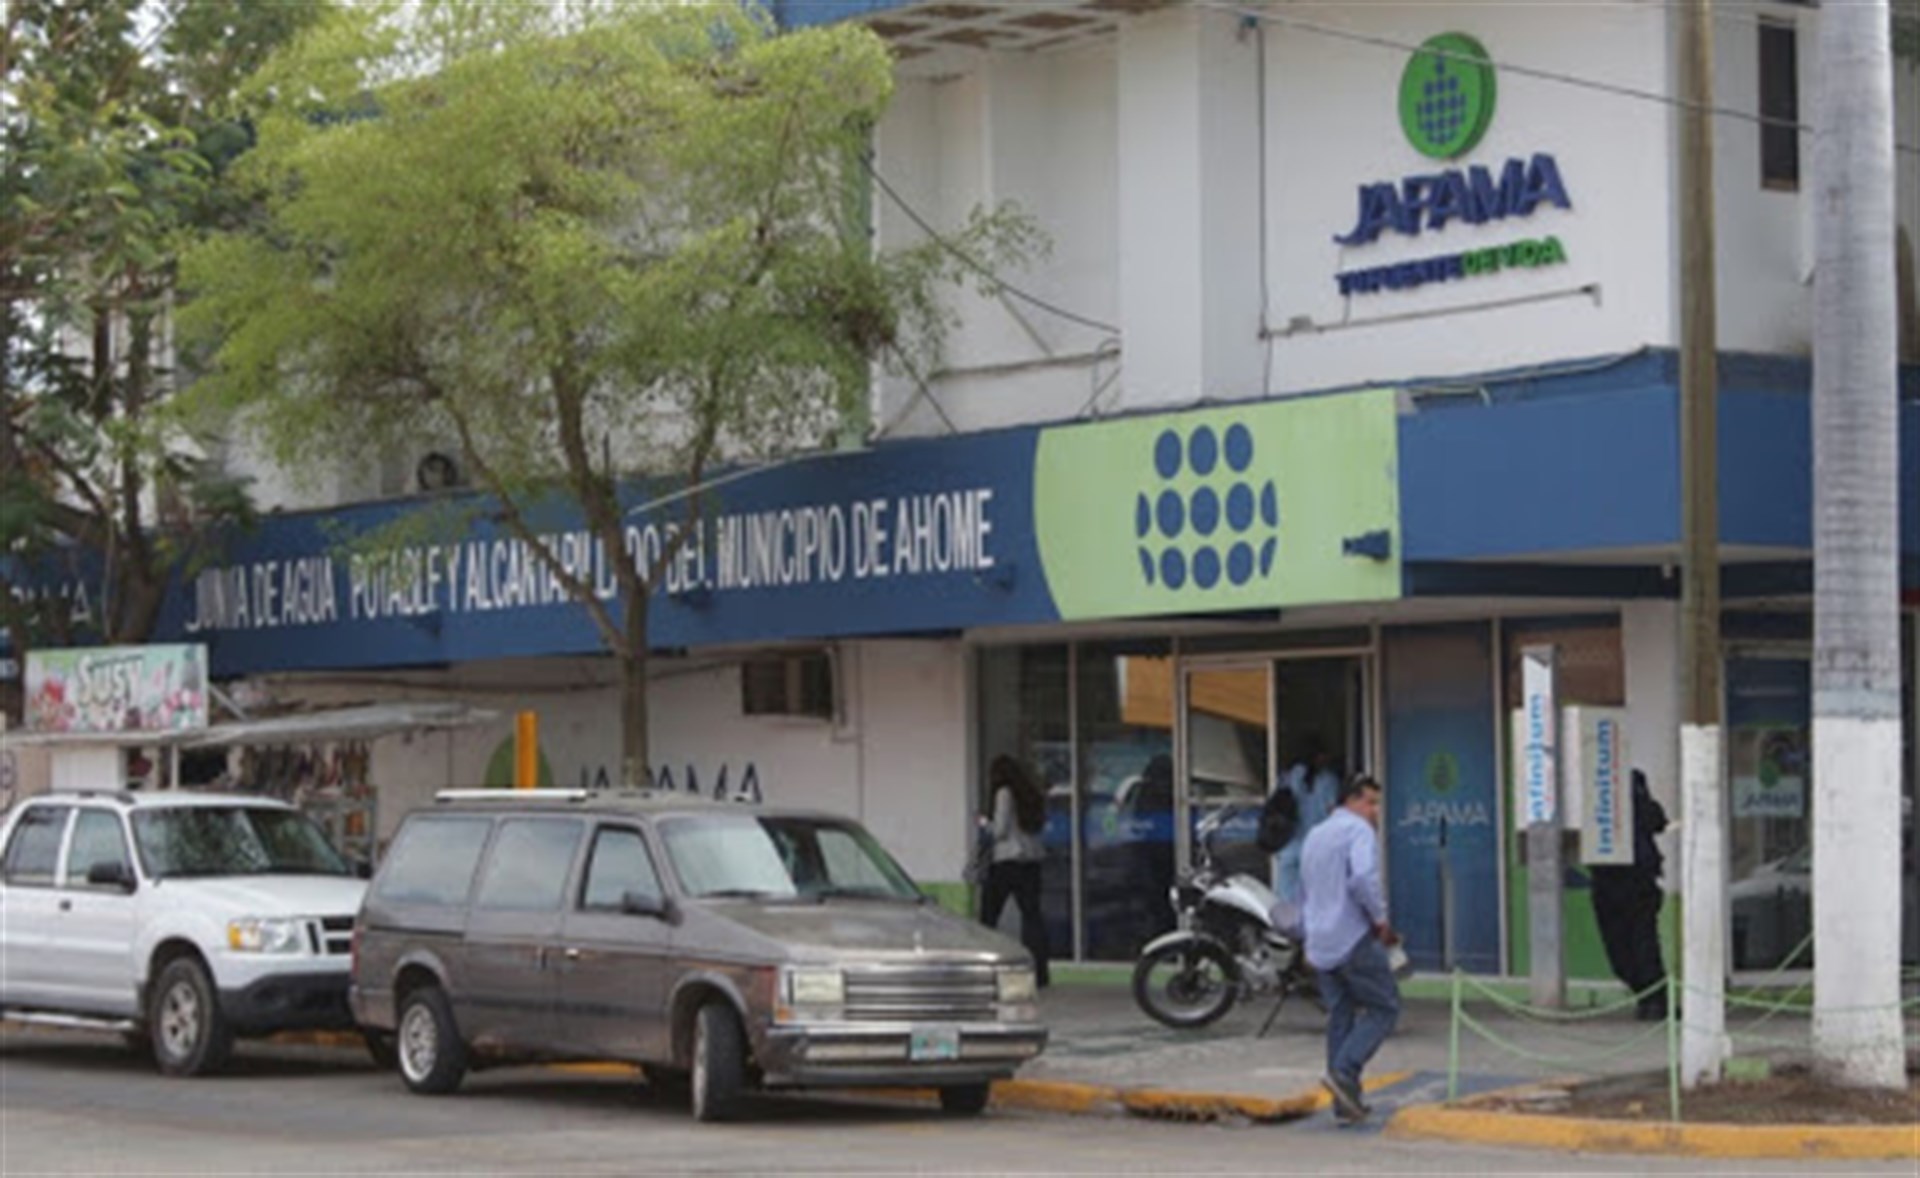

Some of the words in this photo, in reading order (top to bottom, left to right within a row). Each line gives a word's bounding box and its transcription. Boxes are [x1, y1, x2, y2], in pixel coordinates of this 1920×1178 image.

[1333, 152, 1572, 247] JAPAMA
[252, 561, 279, 628] DE
[281, 556, 338, 625] AGUA
[446, 543, 461, 612] Y
[464, 524, 662, 611] ALCANTARILDO
[716, 505, 846, 589] MUNICIPIO
[852, 499, 888, 577] DE
[893, 489, 995, 573] AHOME
